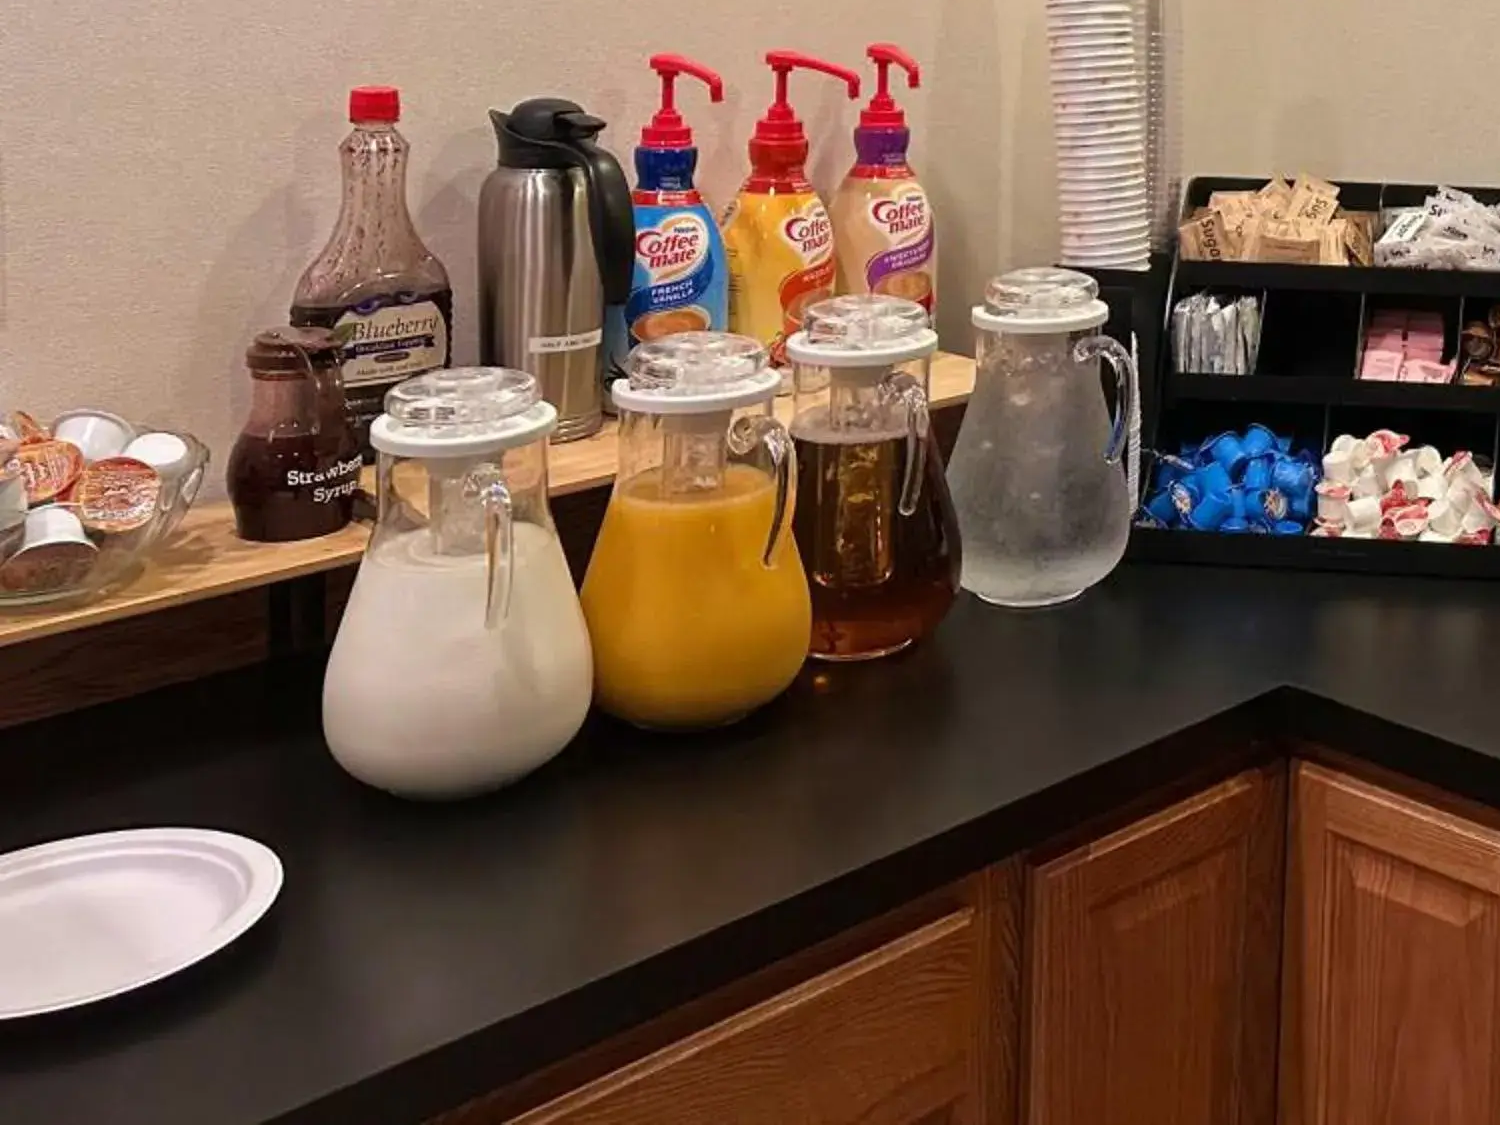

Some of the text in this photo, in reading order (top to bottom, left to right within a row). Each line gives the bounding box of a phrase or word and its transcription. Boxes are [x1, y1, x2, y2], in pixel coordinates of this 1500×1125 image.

[873, 200, 925, 224] Coffee
[888, 215, 925, 234] mate
[636, 230, 699, 259] Coffee
[650, 247, 697, 269] mate
[651, 280, 694, 297] FRENCH
[652, 288, 695, 305] VANILLA
[351, 314, 439, 341] Blueberry
